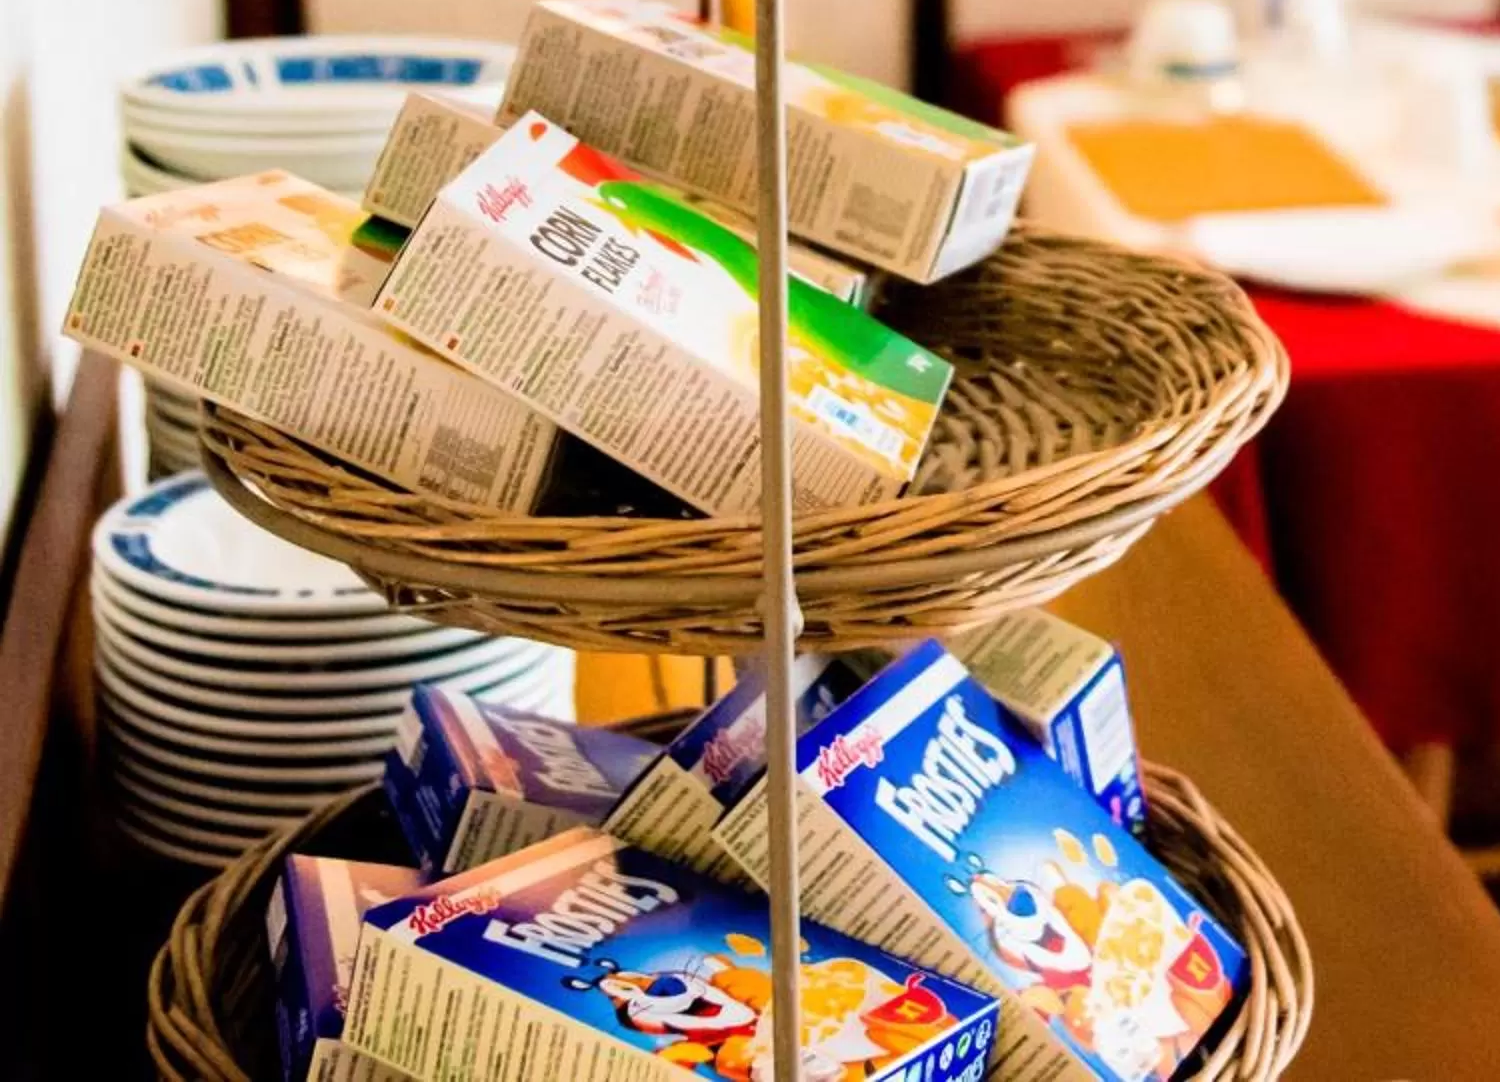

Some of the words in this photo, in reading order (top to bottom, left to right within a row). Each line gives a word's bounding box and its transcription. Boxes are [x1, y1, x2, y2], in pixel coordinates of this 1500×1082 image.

[529, 205, 604, 266] CORN
[580, 236, 641, 294] FLAKES
[817, 724, 883, 788] Kellogg's
[874, 693, 1017, 863] FROSTIES
[409, 886, 502, 935] Kellogg's
[482, 860, 679, 968] FROSTIES
